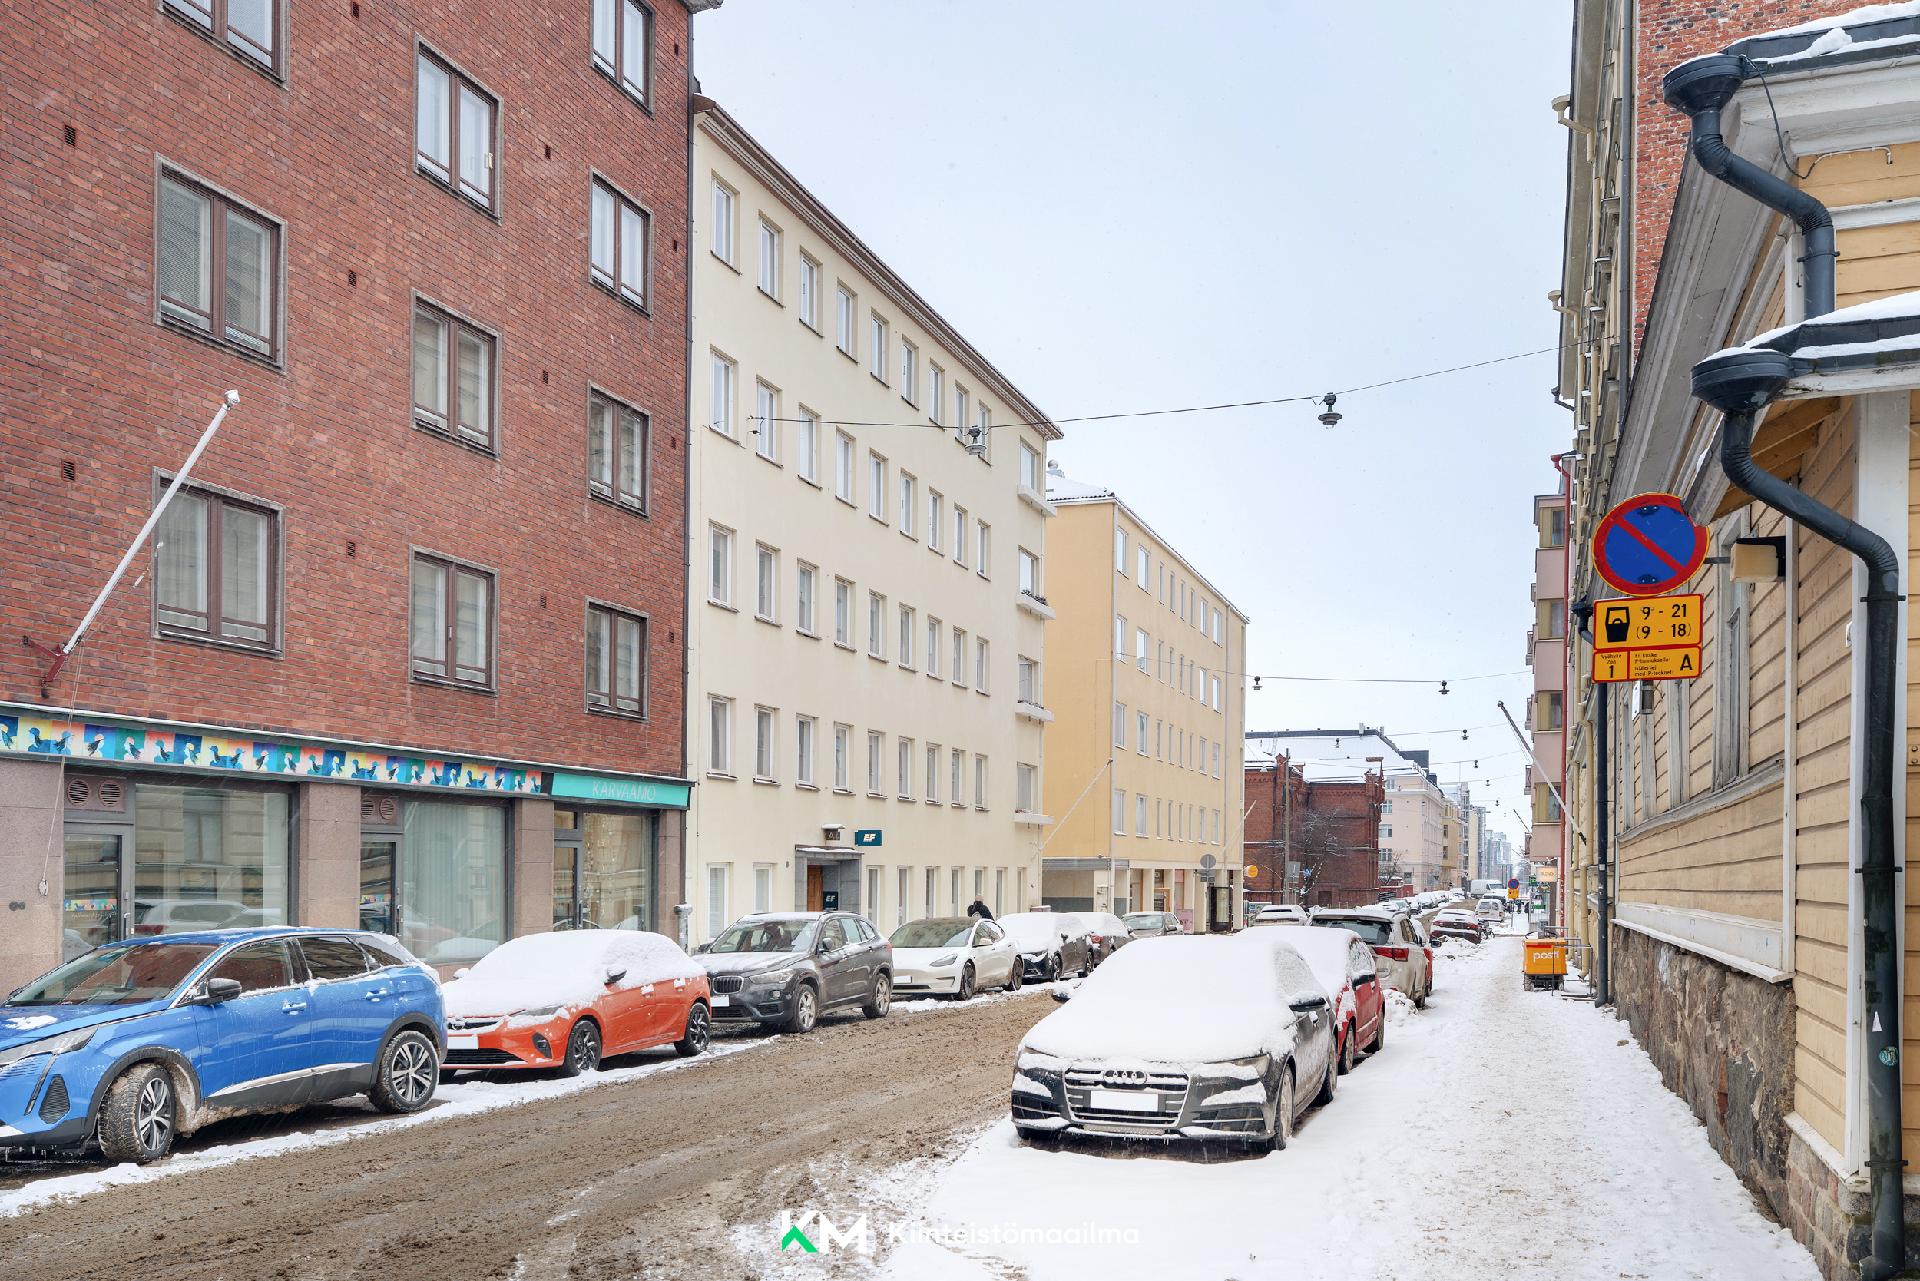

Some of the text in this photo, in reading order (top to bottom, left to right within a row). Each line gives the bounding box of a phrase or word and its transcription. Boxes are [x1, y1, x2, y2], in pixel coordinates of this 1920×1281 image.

[1642, 606, 1651, 620] 9
[1671, 603, 1687, 618] 21
[1671, 623, 1692, 638] 18)
[1679, 653, 1693, 671] A
[1608, 664, 1614, 679] 1
[592, 780, 657, 801] KARVAAMO
[863, 833, 876, 842] EF
[825, 895, 836, 903] EF
[1533, 950, 1559, 963] posti
